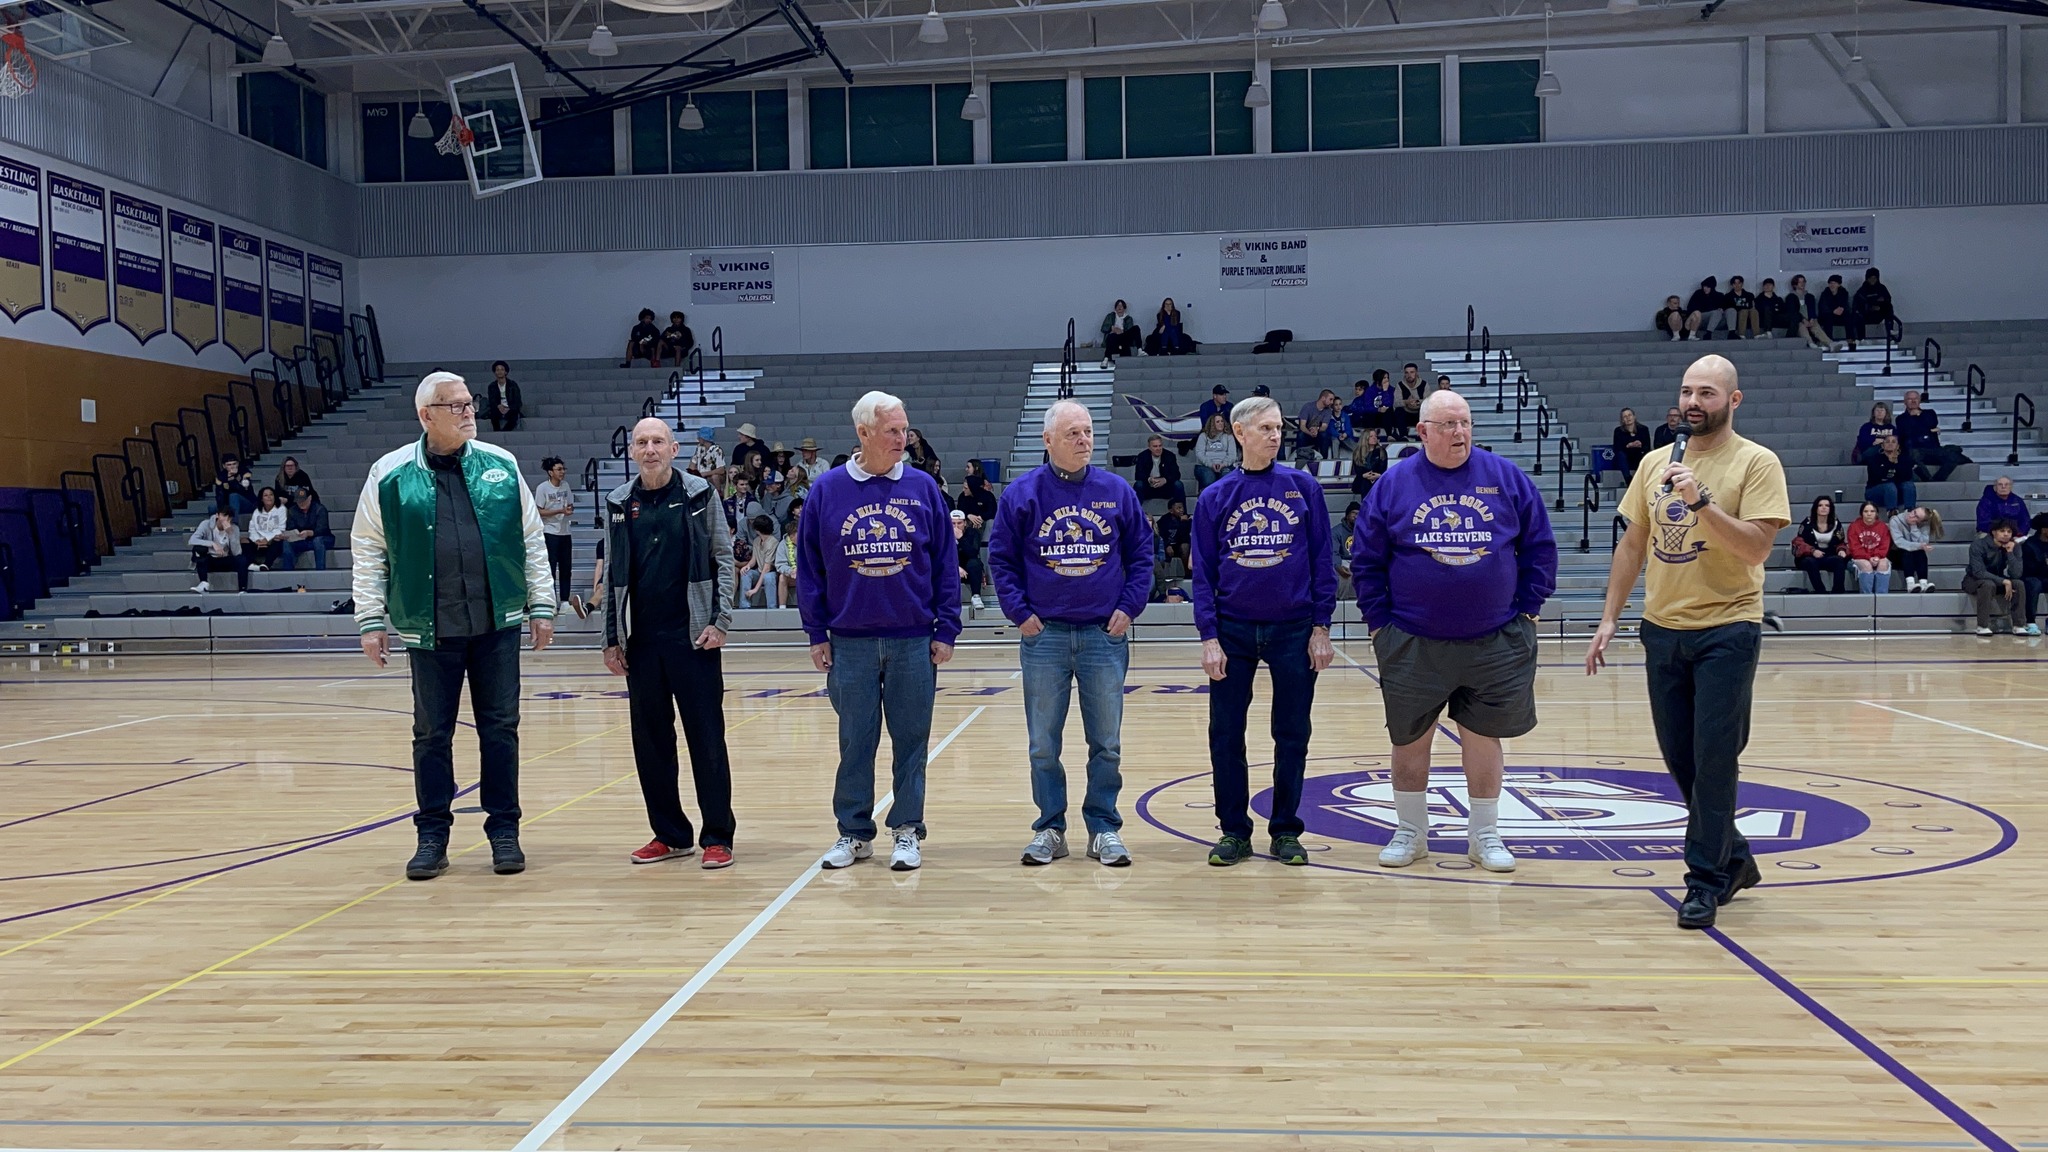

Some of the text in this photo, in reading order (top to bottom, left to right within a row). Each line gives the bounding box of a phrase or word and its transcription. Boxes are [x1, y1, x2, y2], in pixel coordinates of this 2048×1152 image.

[8, 186, 28, 196] CHAMPS
[53, 184, 100, 206] BASKETBALL
[60, 200, 76, 210] WESCO
[76, 203, 94, 214] CHAMPS
[116, 203, 158, 224] BASKETBALL
[12, 224, 36, 236] REGIONAL
[183, 223, 201, 236] GOLF
[1811, 226, 1866, 236] WELCOME
[56, 236, 76, 246] DISTRICT
[80, 240, 101, 252] REGIONAL
[234, 238, 249, 251] GOLF
[1245, 240, 1307, 251] VIKING BAND
[270, 249, 300, 267] SWIMMING
[1260, 254, 1267, 263] &
[311, 262, 340, 278] SWIMMING
[719, 262, 770, 271] VIKING
[1222, 264, 1306, 276] PURPLE THUNDER DRUMLINE
[692, 281, 772, 291] SUPERFANS
[1476, 486, 1499, 494] BENNIE
[1092, 501, 1116, 509] CAPTAIN
[1413, 494, 1494, 524] THE HILL SQUAD
[841, 503, 916, 536] THE HILL SQUAD
[1226, 497, 1300, 532] THE HILL SQUAD
[1039, 505, 1112, 538] THE HILL SQUAD
[1431, 517, 1440, 529] 19
[858, 528, 866, 540] 19
[1240, 522, 1248, 534] 19
[1055, 530, 1063, 542] 19
[1227, 534, 1294, 548] LAKE STEVENS
[1415, 531, 1492, 543] LAKE STEVENS
[844, 542, 912, 556] LAKE STEVENS
[1040, 544, 1110, 556] LAKE STEVENS
[1507, 845, 1685, 855] ST. 19
